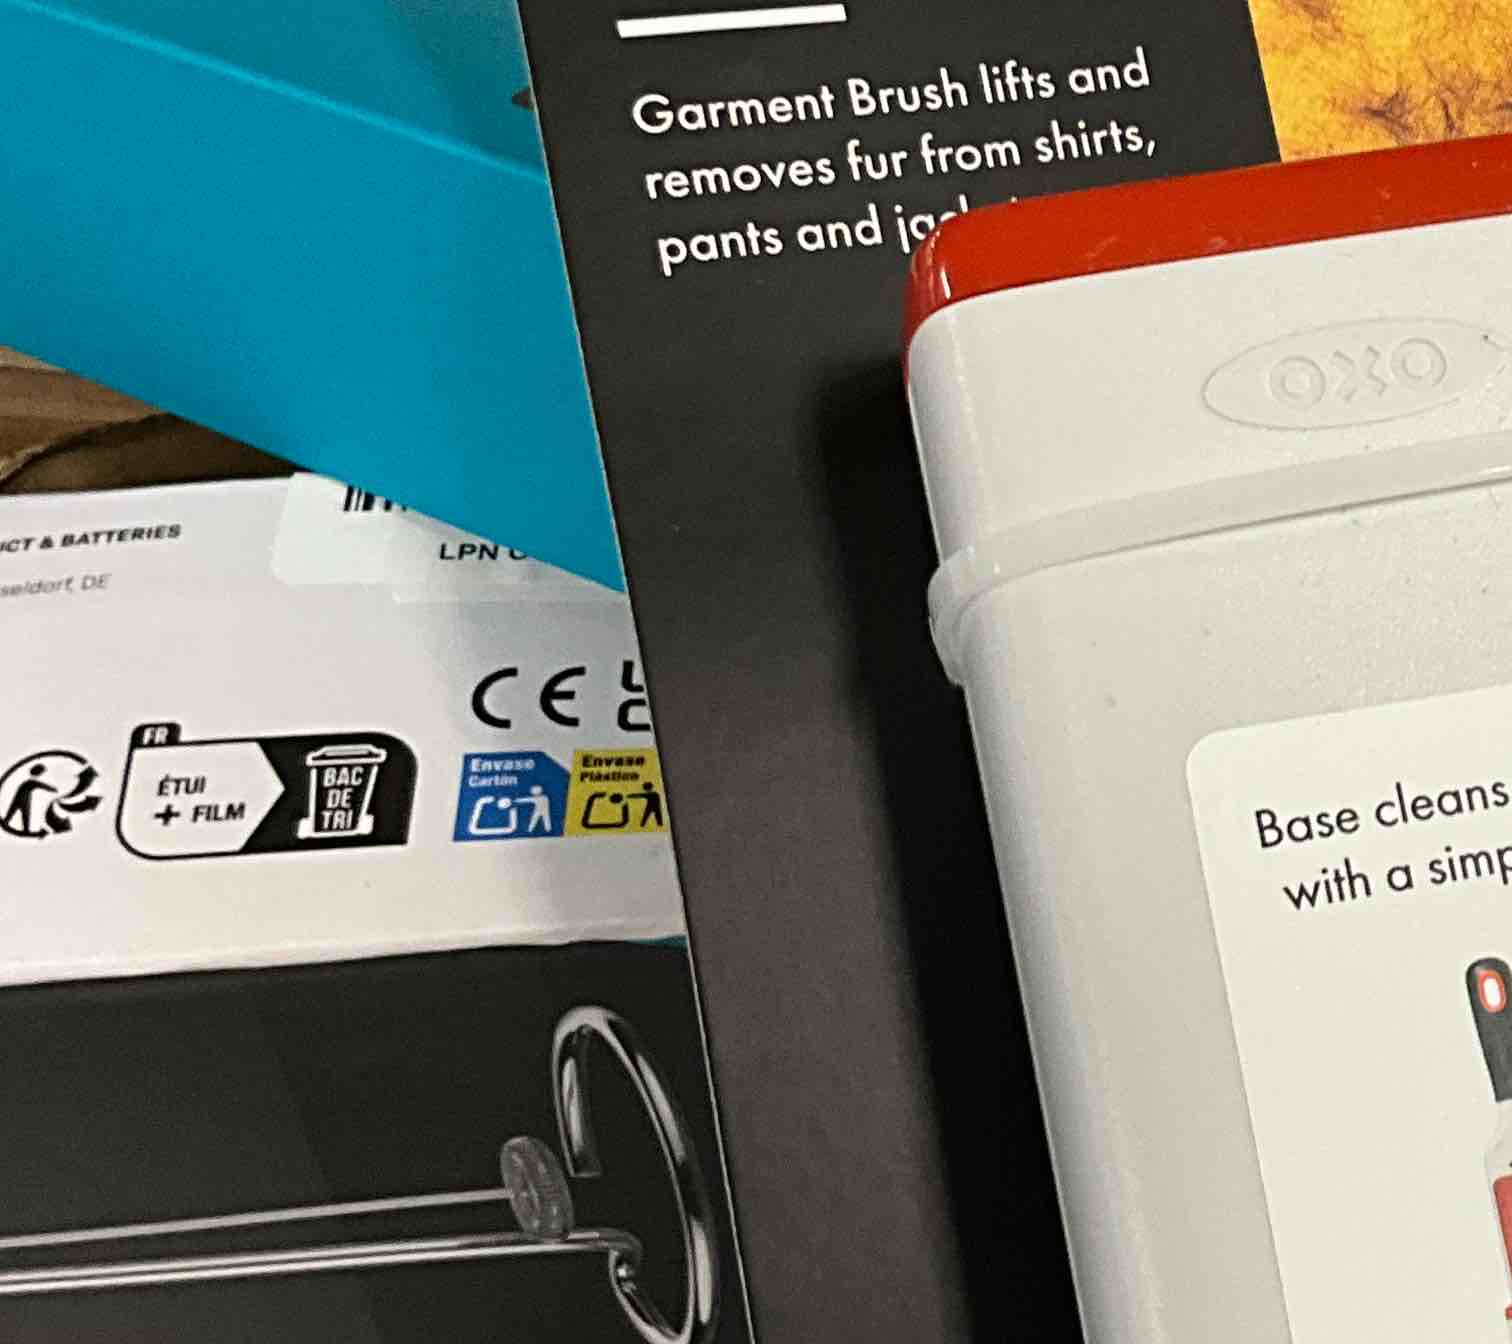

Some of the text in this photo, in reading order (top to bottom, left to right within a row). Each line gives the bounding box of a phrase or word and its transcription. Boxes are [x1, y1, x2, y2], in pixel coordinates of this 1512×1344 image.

[632, 46, 1151, 135] Garment Brush lifts and
[644, 121, 1158, 200] removes fur from shirts,
[656, 216, 784, 277] pants
[796, 202, 882, 253] and
[1269, 336, 1448, 408] OXO
[39, 536, 54, 550] &
[61, 524, 182, 548] BATTERIES
[439, 542, 499, 562] LPN
[80, 573, 111, 591] DE
[143, 727, 169, 745] FR
[471, 758, 535, 772] Envase
[582, 755, 645, 768] Envase
[157, 774, 206, 797] ÉTUI
[323, 767, 364, 787] BAC
[326, 788, 353, 808] DE
[192, 802, 246, 823] FILM
[322, 809, 353, 831] TRI
[1255, 806, 1361, 849] Base
[1375, 782, 1510, 828] cleans
[1283, 857, 1373, 911] with
[1386, 864, 1415, 892] a
